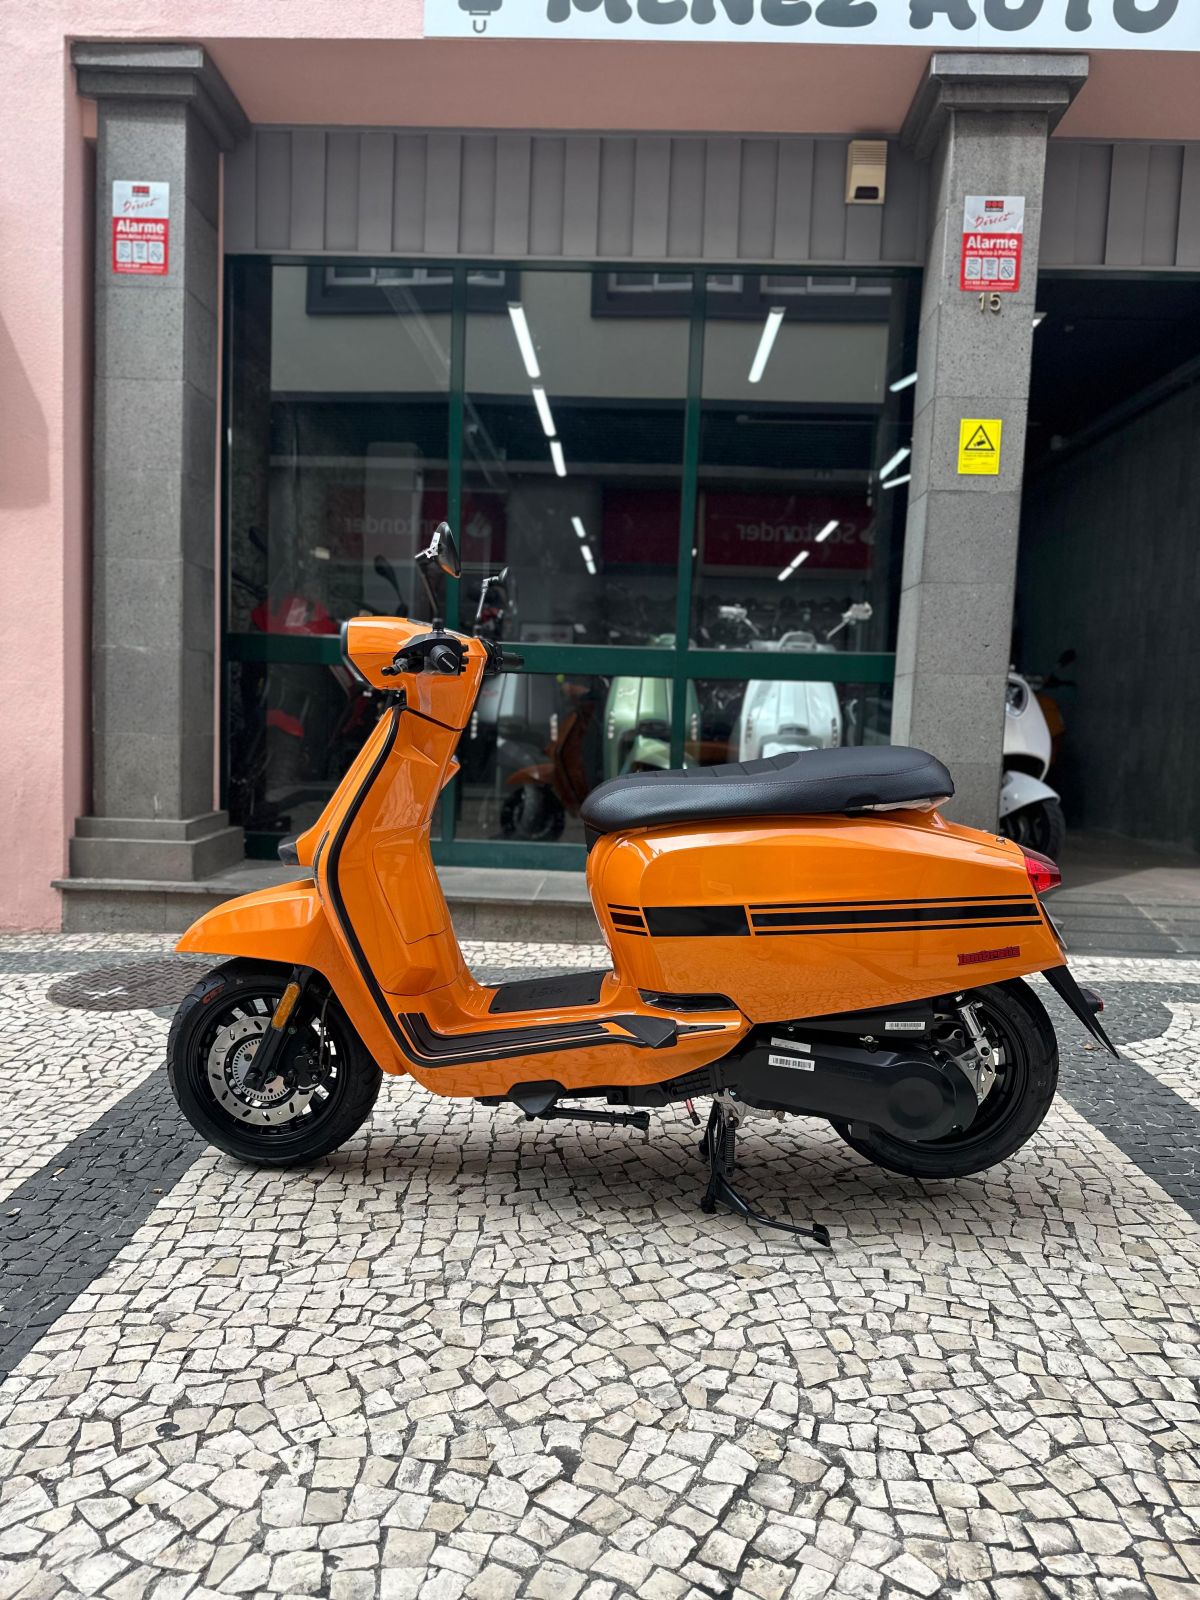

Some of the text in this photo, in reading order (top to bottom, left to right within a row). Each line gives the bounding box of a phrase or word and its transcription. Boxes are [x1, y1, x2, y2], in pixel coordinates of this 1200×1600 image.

[116, 219, 165, 234] Alarme
[966, 235, 1018, 249] Alarme
[979, 292, 1001, 312] 15
